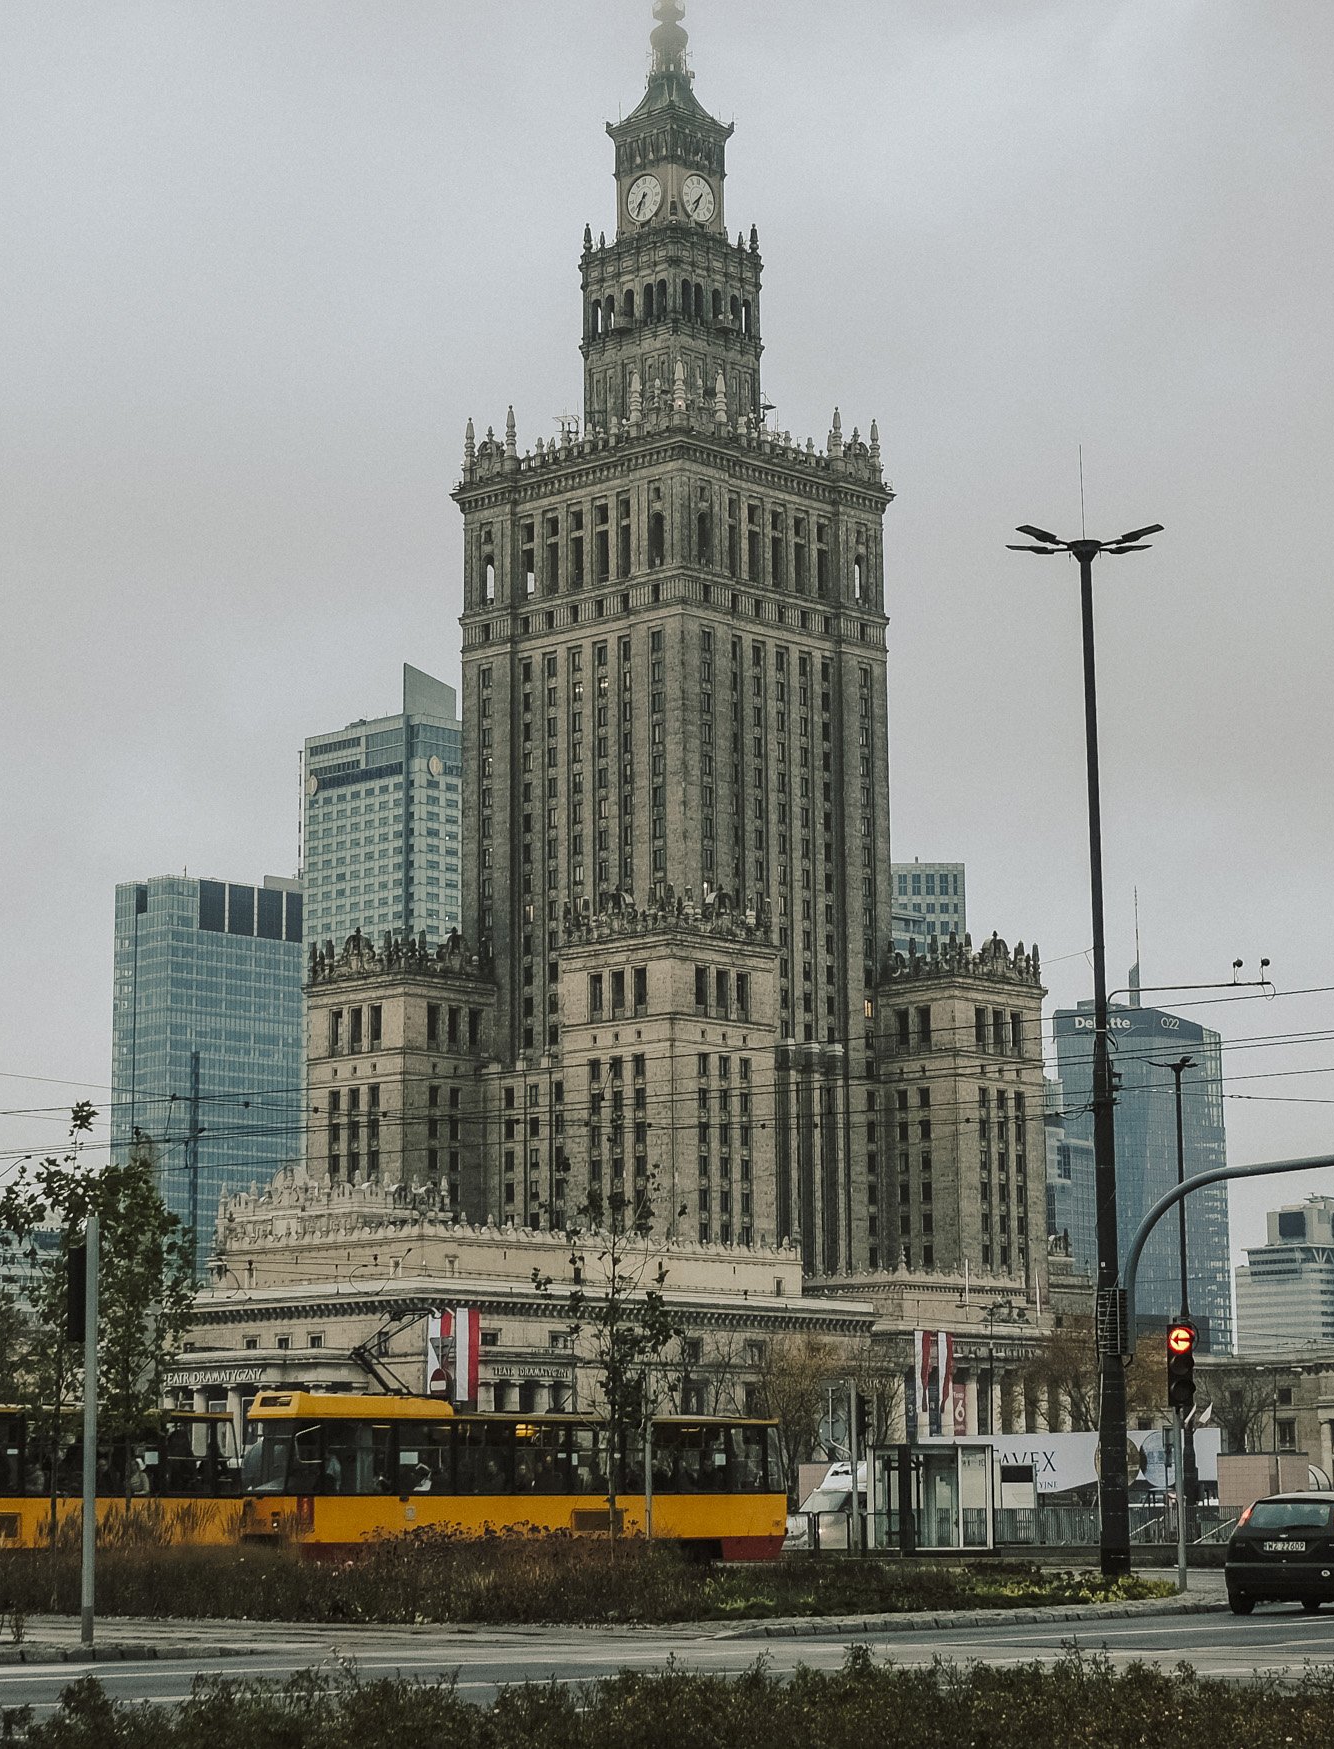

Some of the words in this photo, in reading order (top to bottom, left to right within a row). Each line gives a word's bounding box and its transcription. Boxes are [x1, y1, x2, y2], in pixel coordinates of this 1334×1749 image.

[1075, 1016, 1131, 1029] Deltte
[165, 1372, 189, 1385] EATR
[192, 1368, 263, 1384] DRAMATYCZNY
[492, 1366, 515, 1376] TEATR
[954, 1399, 965, 1422] 6
[993, 1450, 1056, 1473] AVEX
